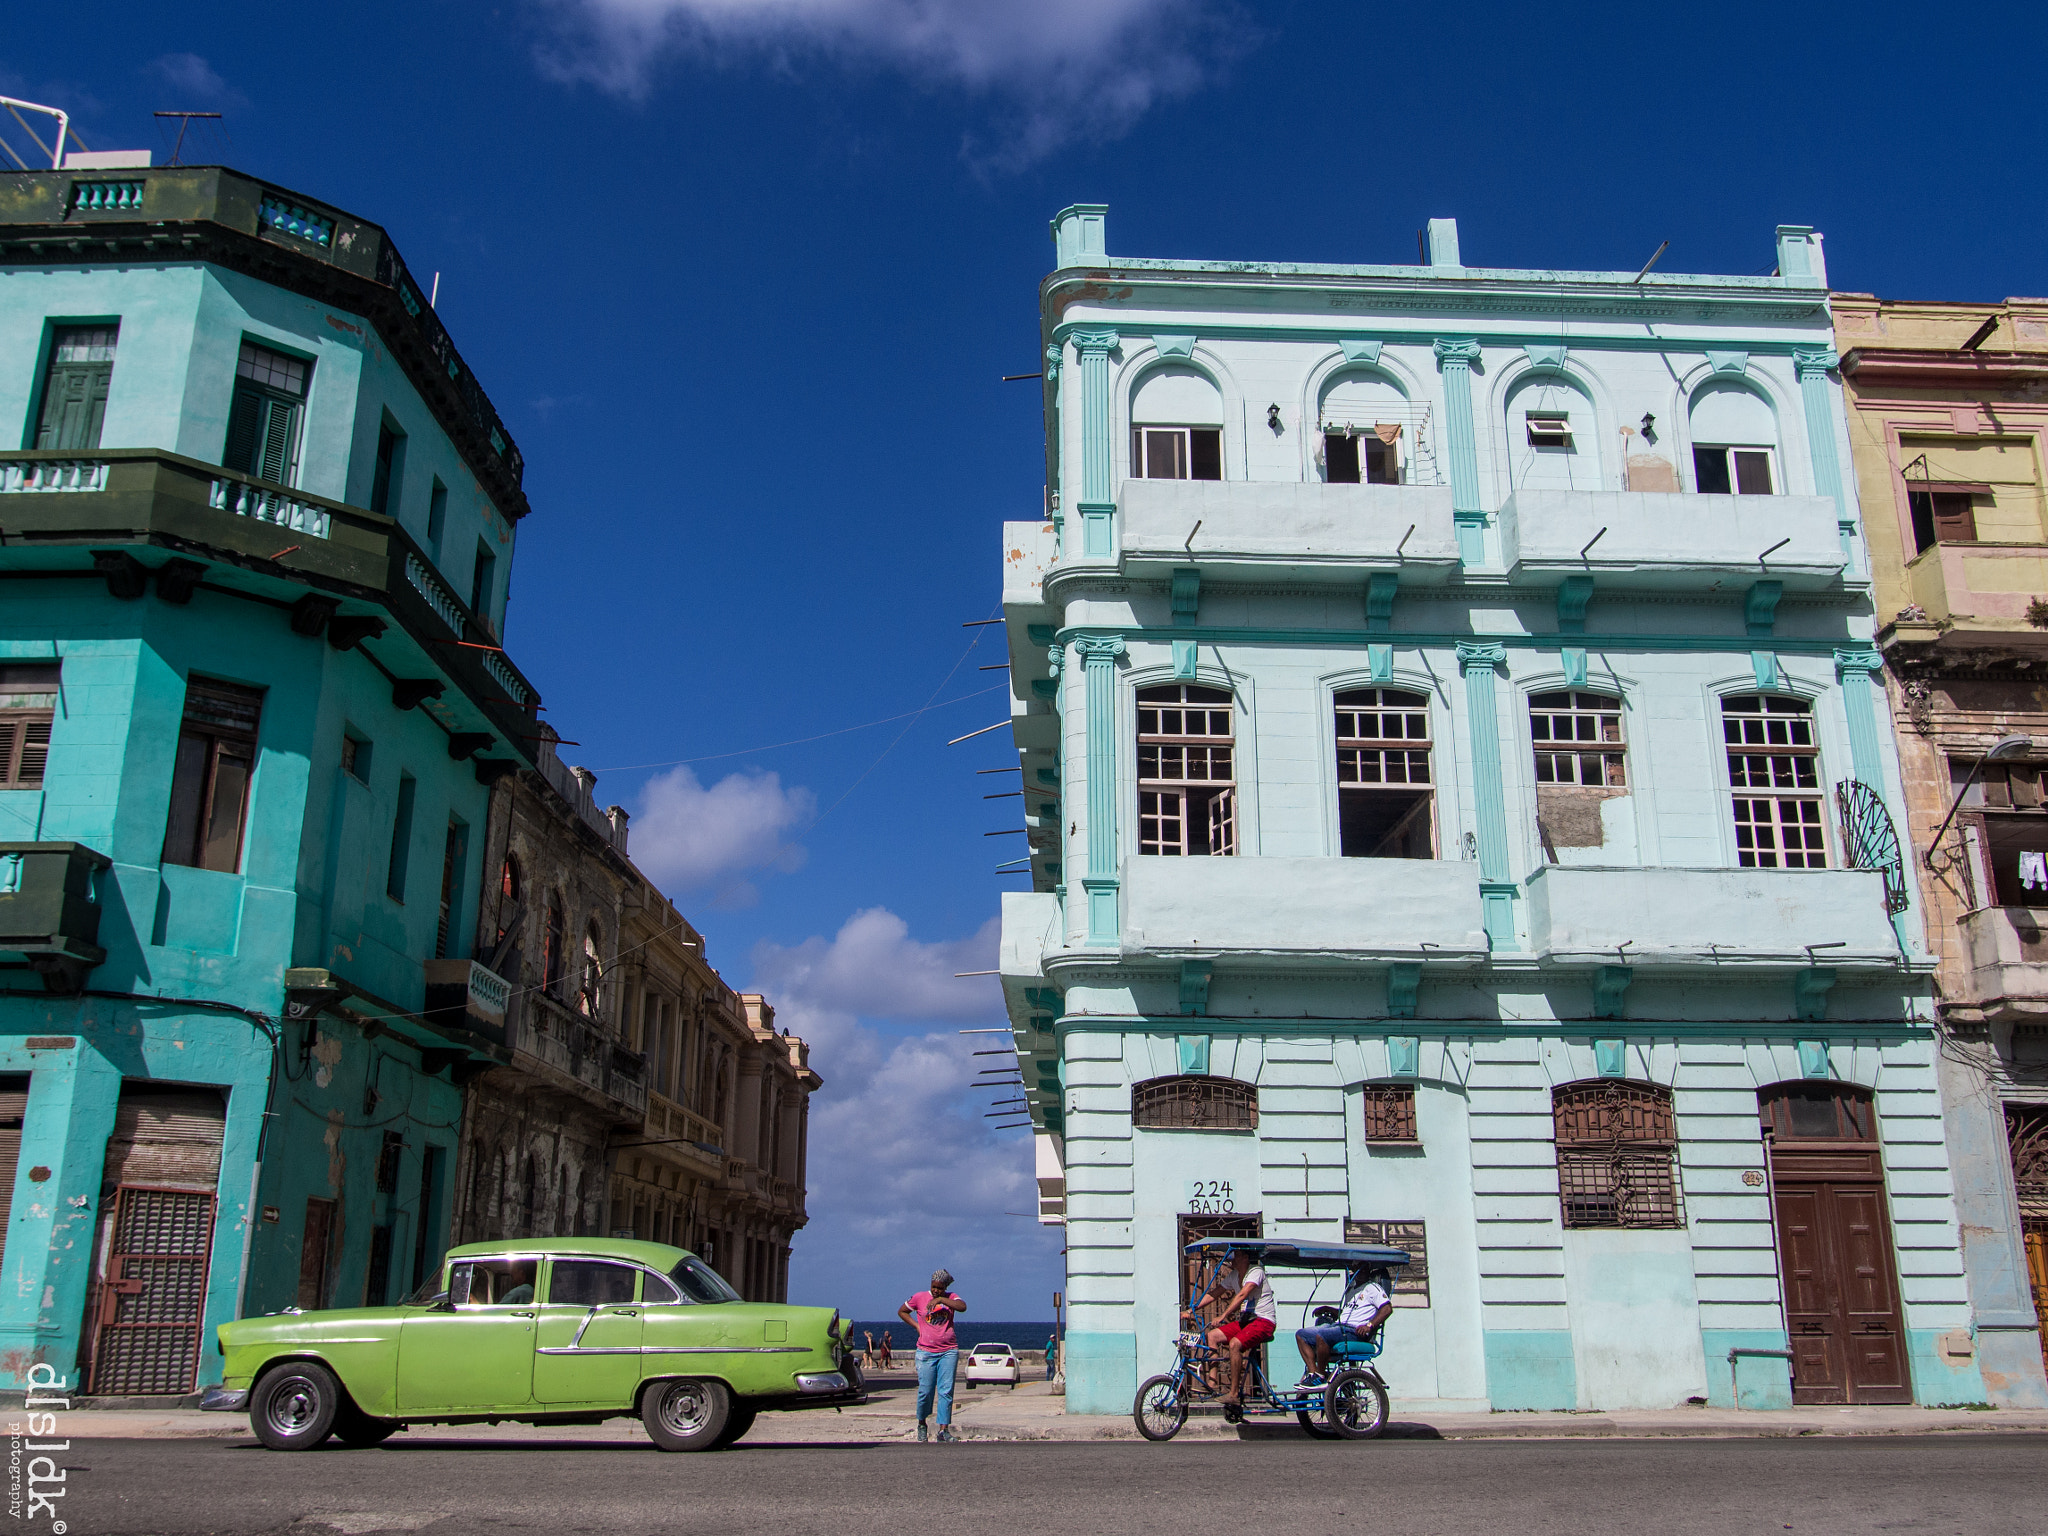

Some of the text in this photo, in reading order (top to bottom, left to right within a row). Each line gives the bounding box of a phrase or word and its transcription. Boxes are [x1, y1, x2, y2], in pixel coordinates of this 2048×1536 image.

[1193, 1180, 1234, 1198] 224
[1188, 1198, 1234, 1215] BAJO
[1179, 1333, 1199, 1342] TAXI
